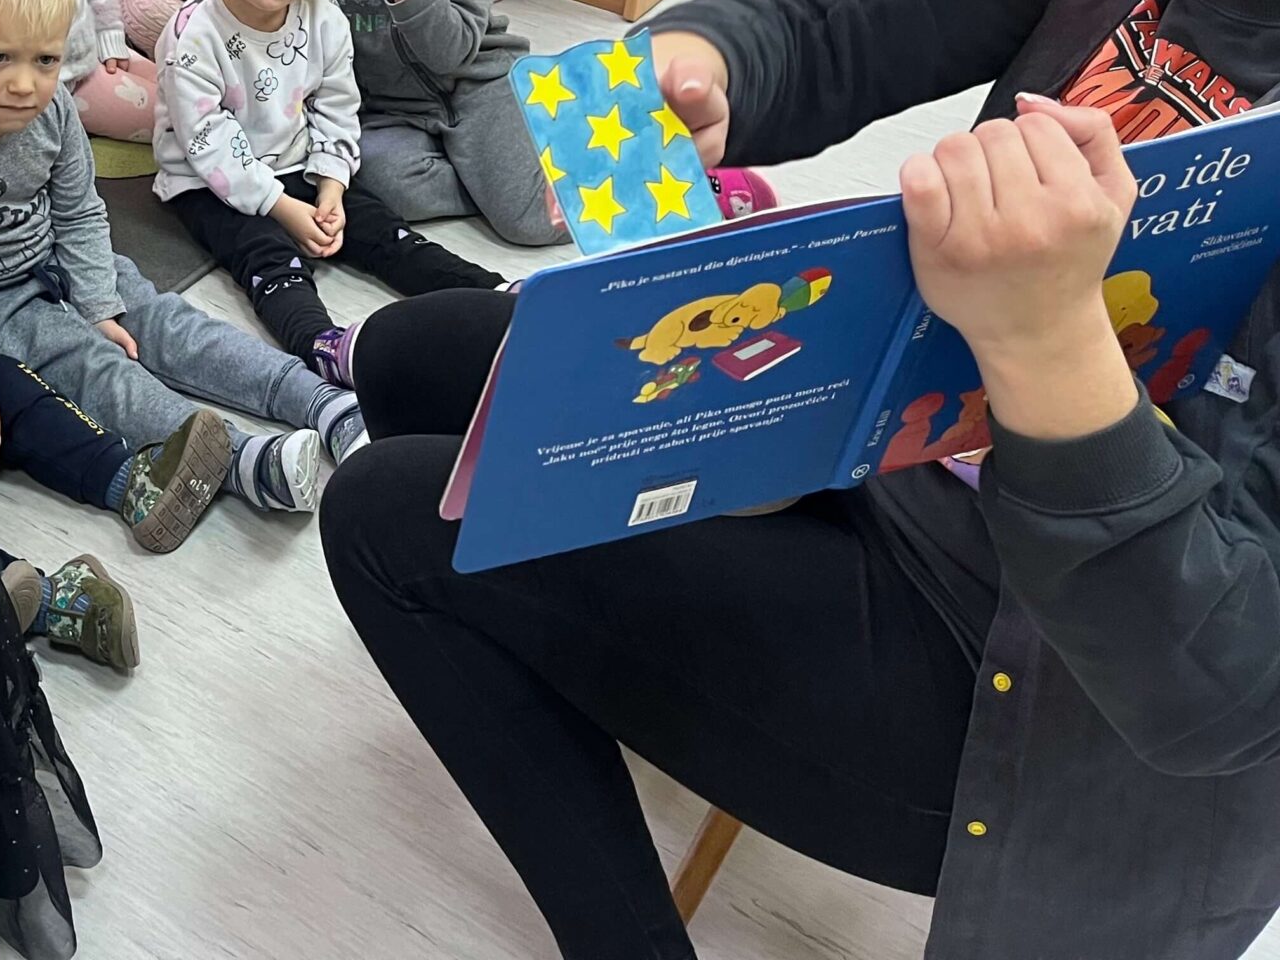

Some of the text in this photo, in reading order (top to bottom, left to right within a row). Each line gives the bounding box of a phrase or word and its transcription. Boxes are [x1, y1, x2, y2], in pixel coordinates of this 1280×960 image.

[1176, 146, 1251, 191] ide
[1130, 189, 1223, 240] vati
[636, 275, 650, 288] je
[652, 264, 702, 283] sastavni
[704, 258, 724, 273] dio
[807, 233, 851, 250] časopis
[852, 223, 898, 239] Parents
[537, 440, 585, 456] Vrijeme
[585, 436, 599, 447] je
[601, 433, 615, 442] za
[676, 413, 692, 426] ali
[694, 408, 722, 422] Piko
[724, 399, 763, 414] mnogo
[764, 392, 792, 406] puta
[794, 386, 824, 399] mora
[590, 413, 785, 468] pridruži se zabavi prije spavanja!
[607, 438, 638, 453] prije
[640, 432, 669, 446] nego
[670, 426, 689, 438] što
[728, 407, 767, 424] Otvori
